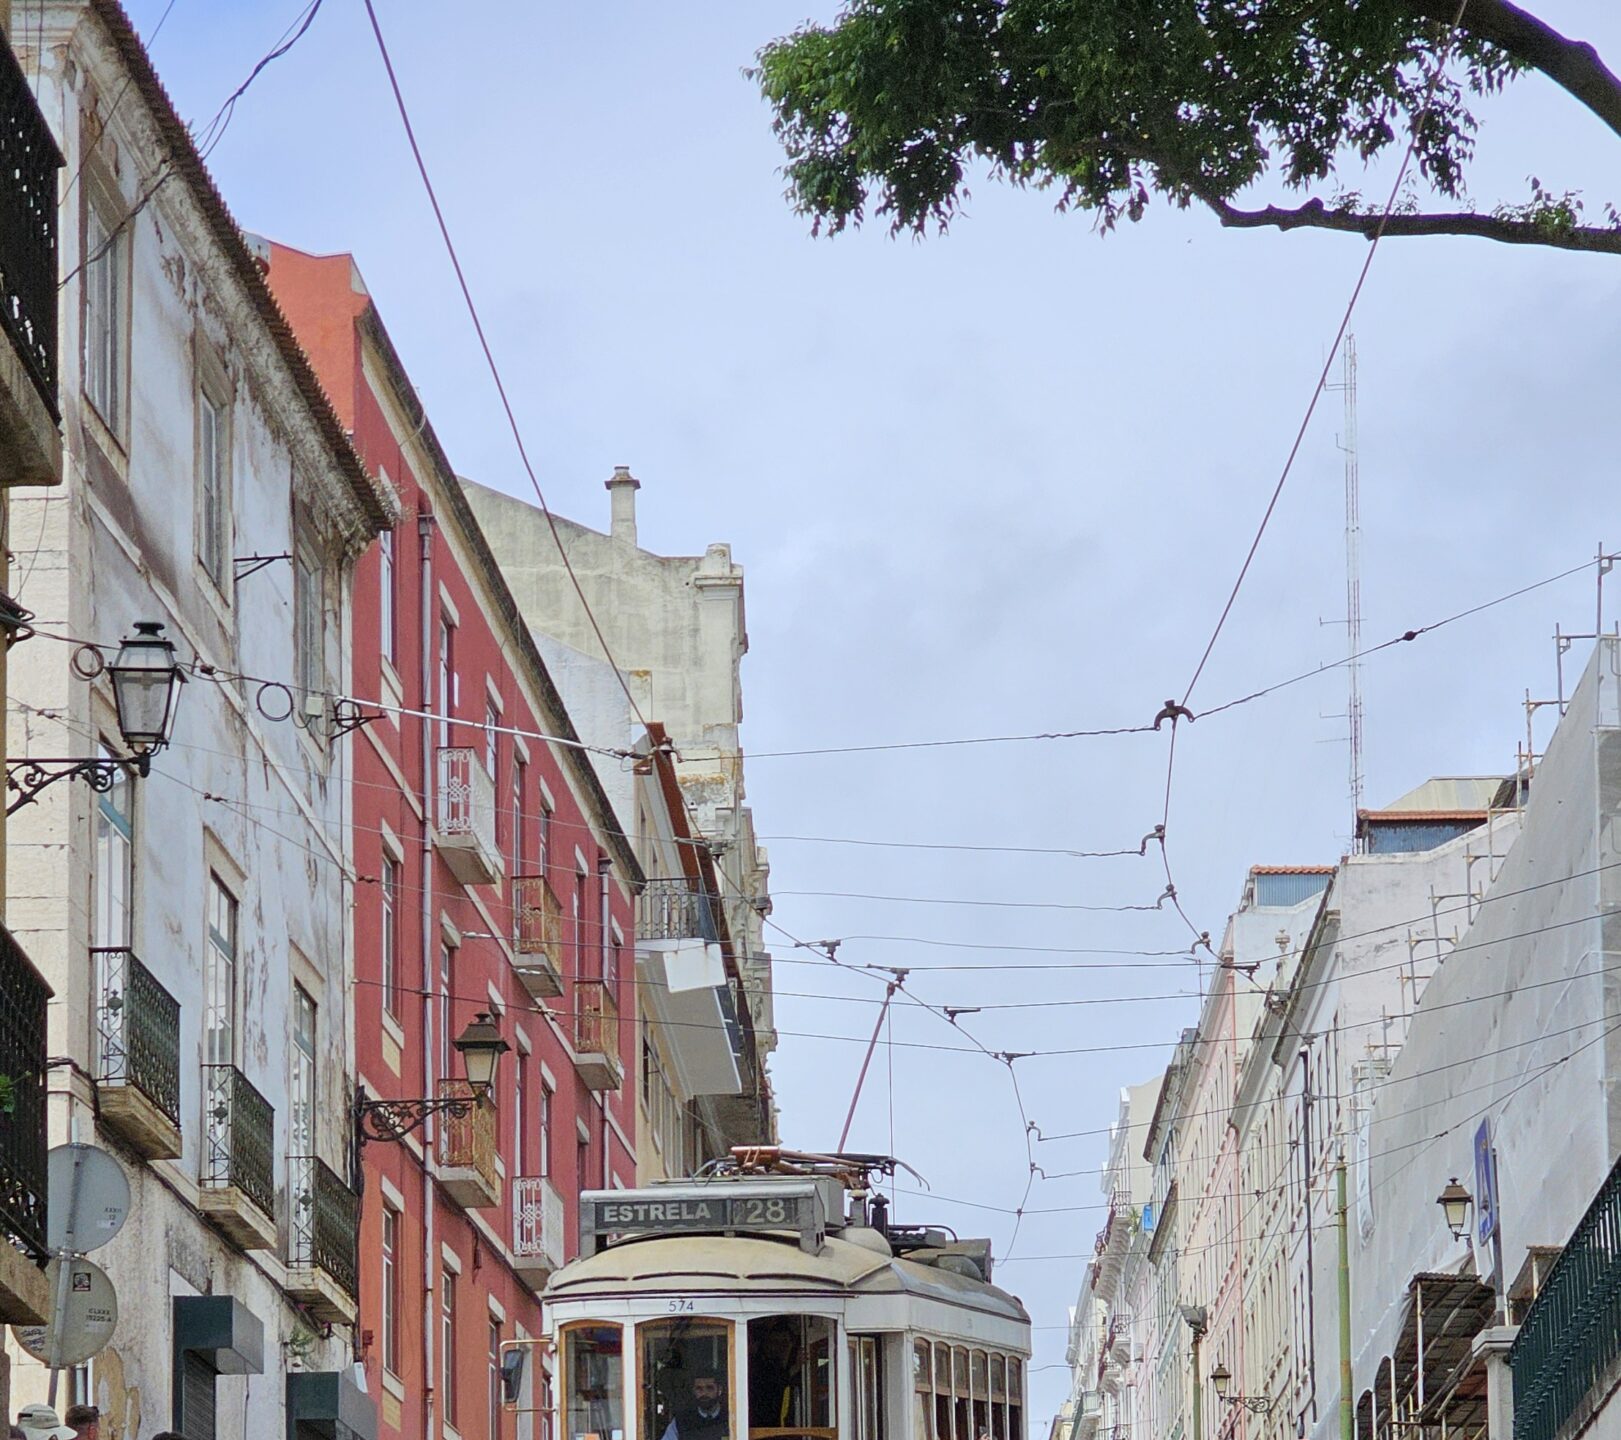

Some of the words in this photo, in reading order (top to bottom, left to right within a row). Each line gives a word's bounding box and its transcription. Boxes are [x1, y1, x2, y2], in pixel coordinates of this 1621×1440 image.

[604, 1203, 711, 1222] ESTRELA
[746, 1200, 786, 1223] 28
[669, 1301, 694, 1312] 574
